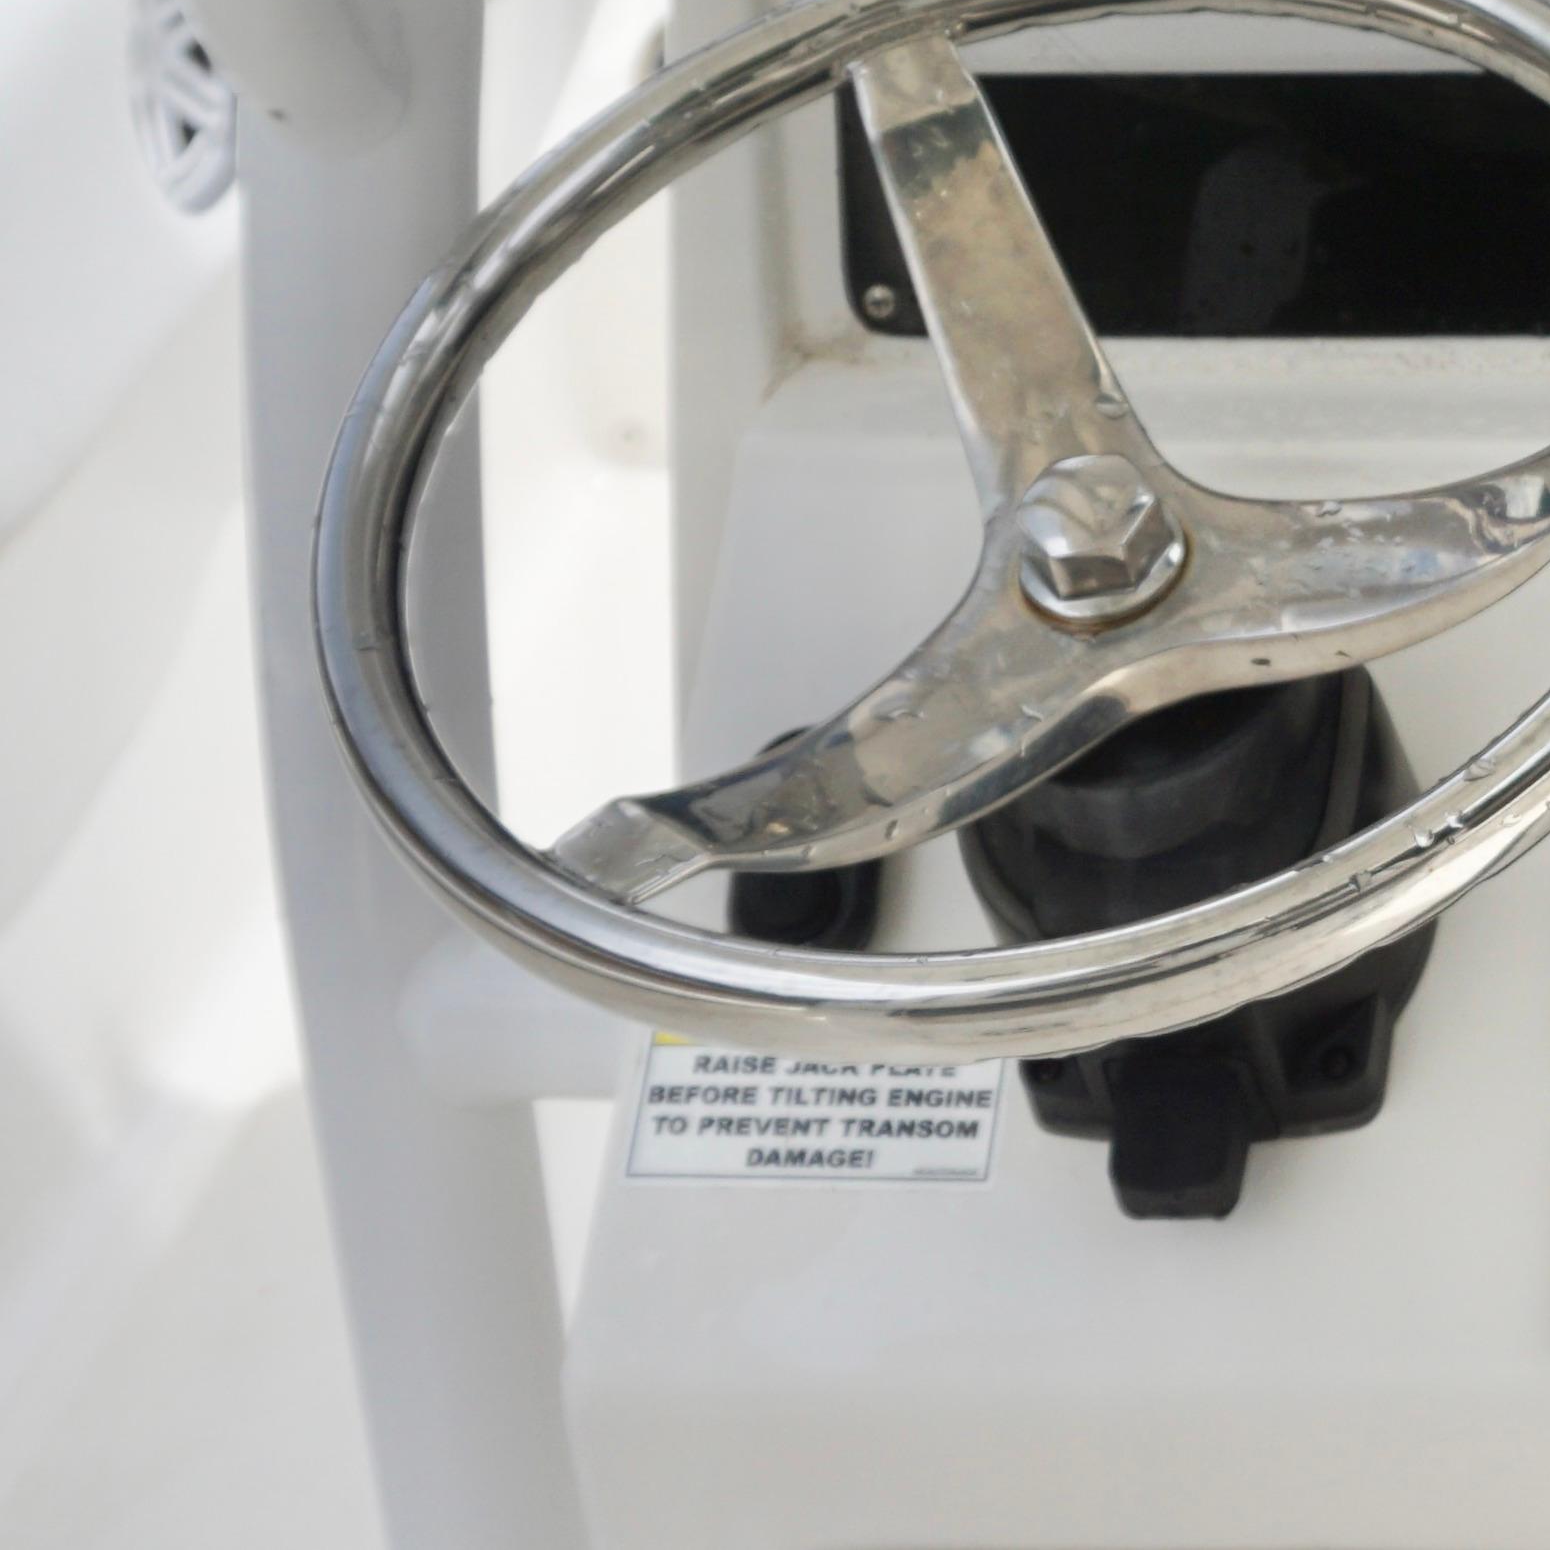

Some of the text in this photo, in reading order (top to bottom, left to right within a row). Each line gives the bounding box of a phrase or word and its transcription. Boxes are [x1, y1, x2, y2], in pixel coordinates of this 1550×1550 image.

[692, 1055, 776, 1075] RAISE
[647, 1086, 992, 1108] BEFORE TILTING ENGINE
[654, 1116, 979, 1138] TO PREVENT TRANSOM
[745, 1148, 874, 1169] DAMAGE!
